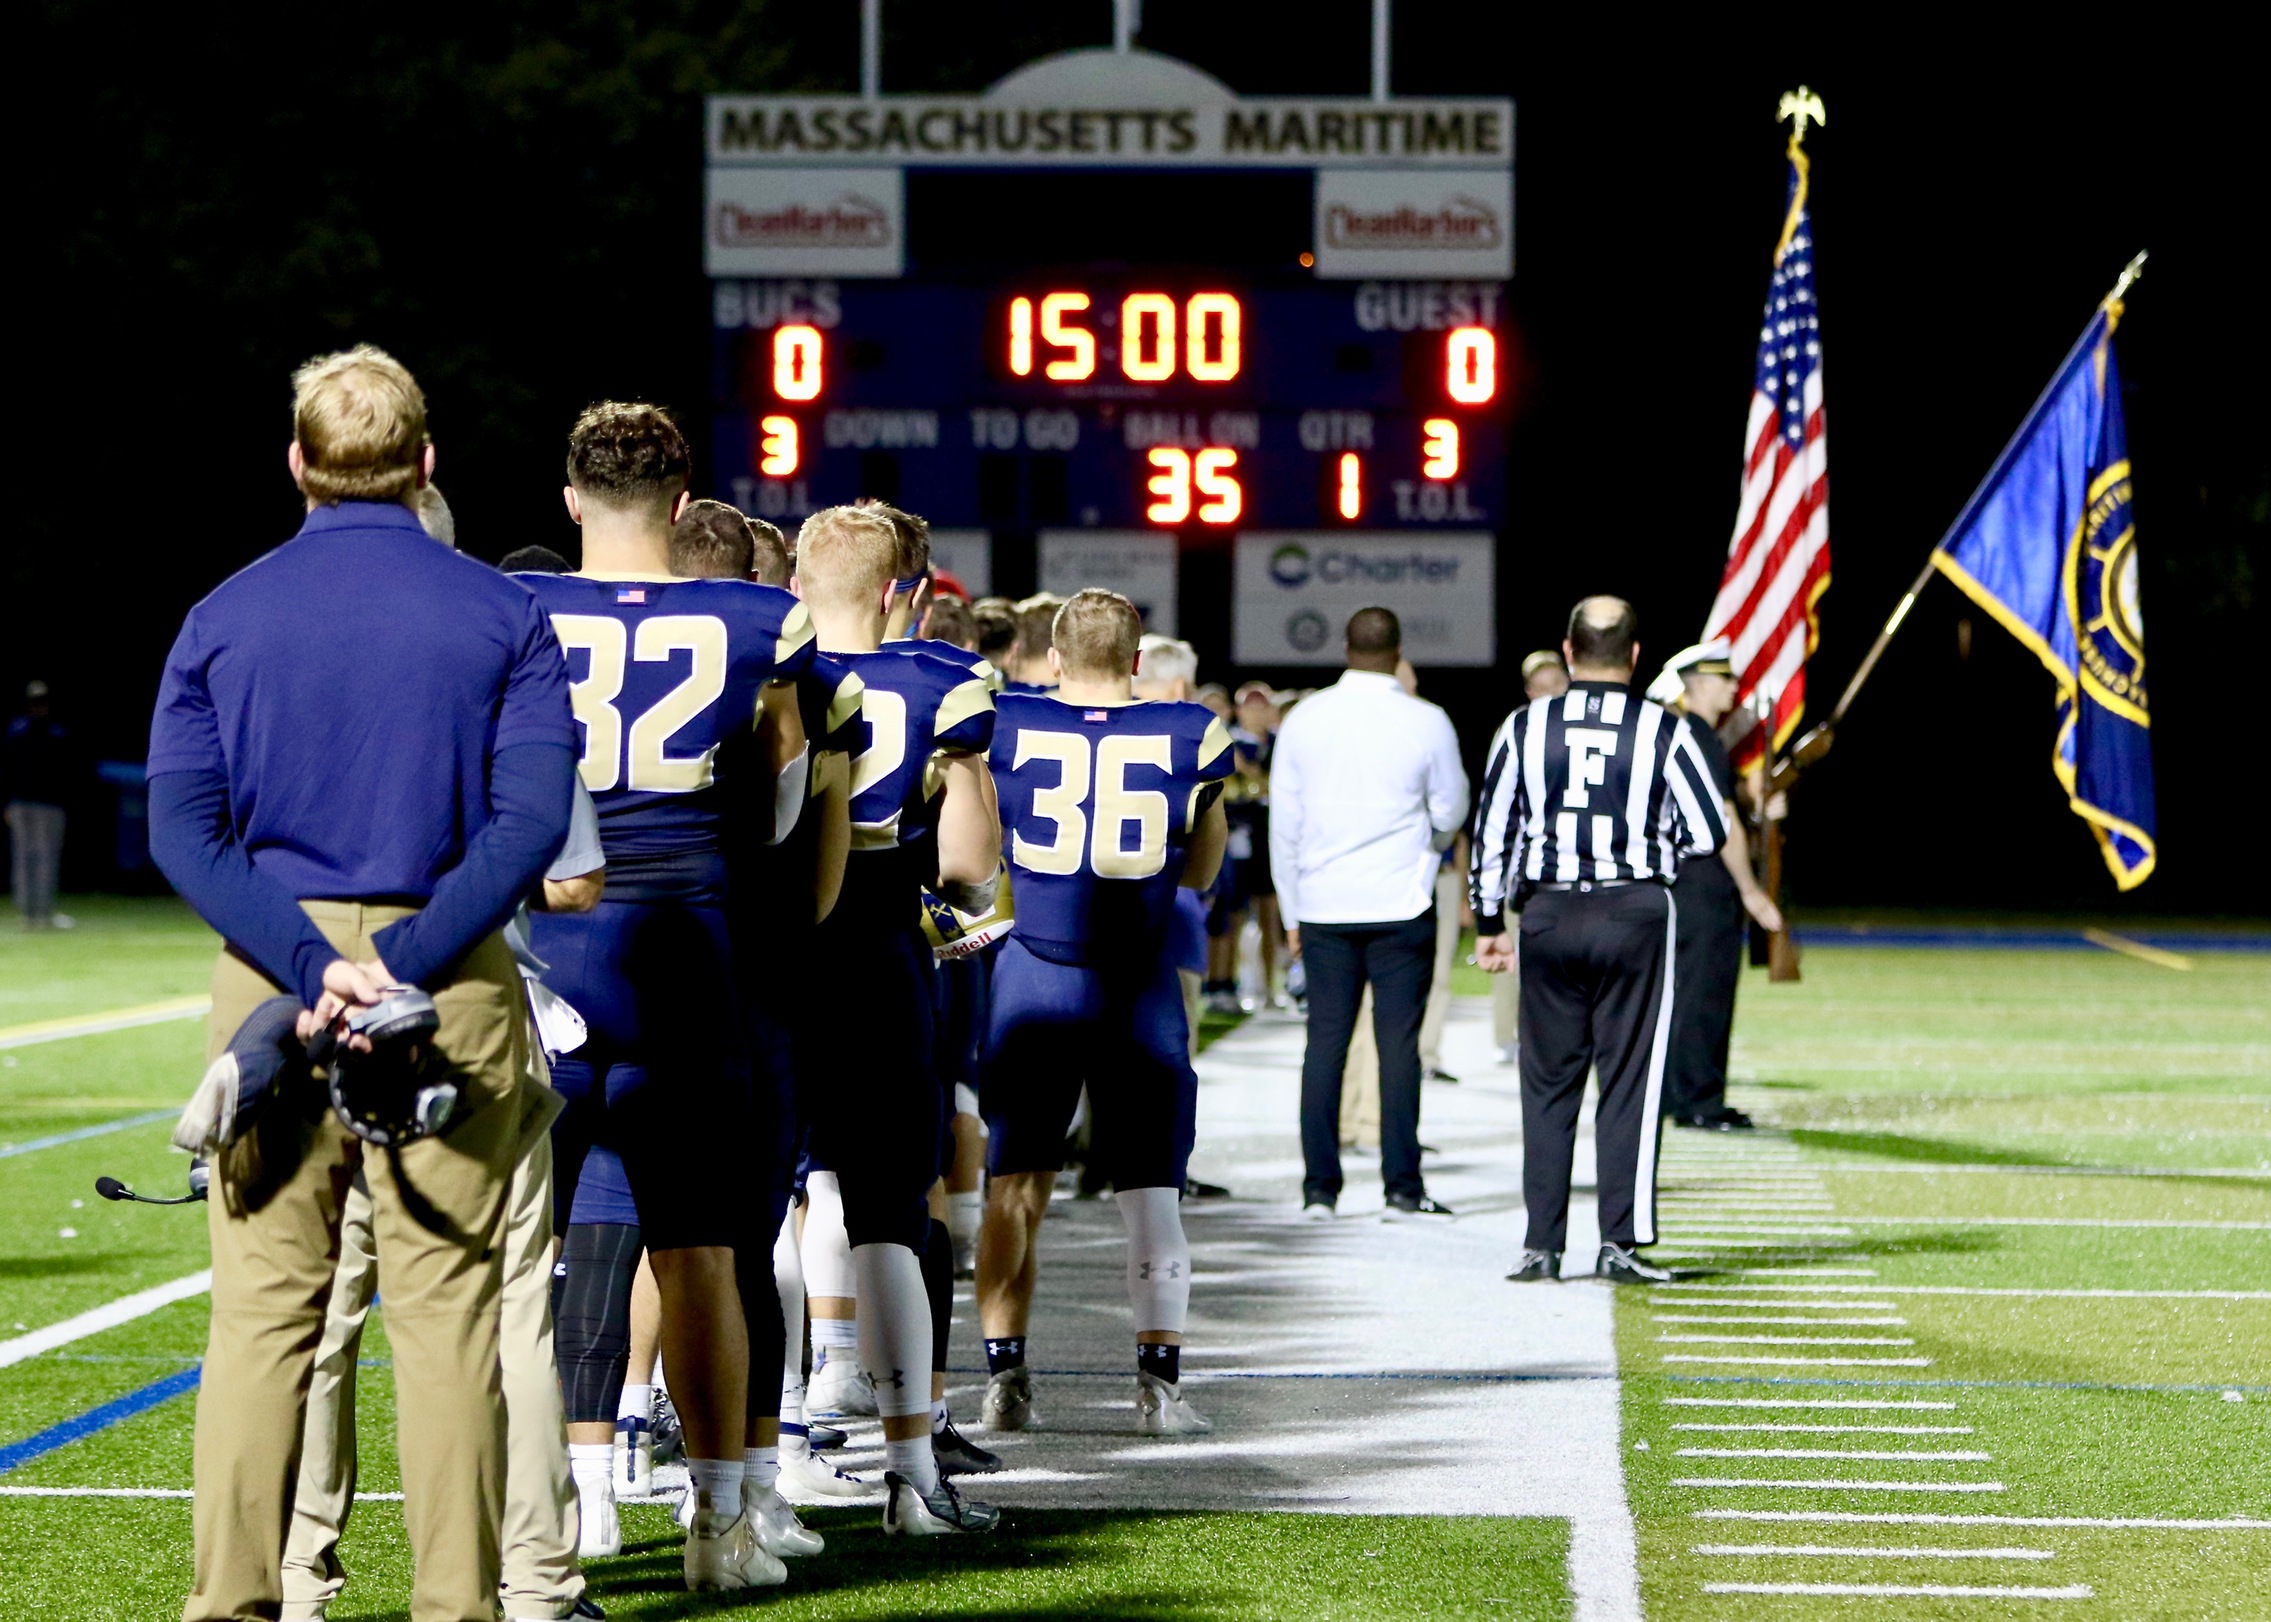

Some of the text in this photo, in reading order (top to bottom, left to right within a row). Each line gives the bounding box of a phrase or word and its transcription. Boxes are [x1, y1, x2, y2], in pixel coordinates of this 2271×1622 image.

[719, 108, 1503, 154] MASSACHUSETTS MARITIME
[713, 281, 842, 328] BUCS
[1354, 283, 1502, 331] GUEST
[773, 324, 823, 401] 0
[1447, 326, 1496, 403] 0
[760, 414, 799, 476] 3
[824, 410, 940, 449] DOWN
[971, 408, 1081, 452] TO GO
[1124, 411, 1261, 450] BALL ON
[1298, 410, 1374, 452] QTR
[1422, 418, 1460, 479] 3
[1146, 446, 1242, 524] 35
[1338, 451, 1361, 520] 1
[1316, 549, 1460, 584] Charter
[549, 614, 728, 793] 32
[1562, 727, 1618, 808] F
[1011, 728, 1173, 880] 36
[937, 931, 992, 959] Riddell
